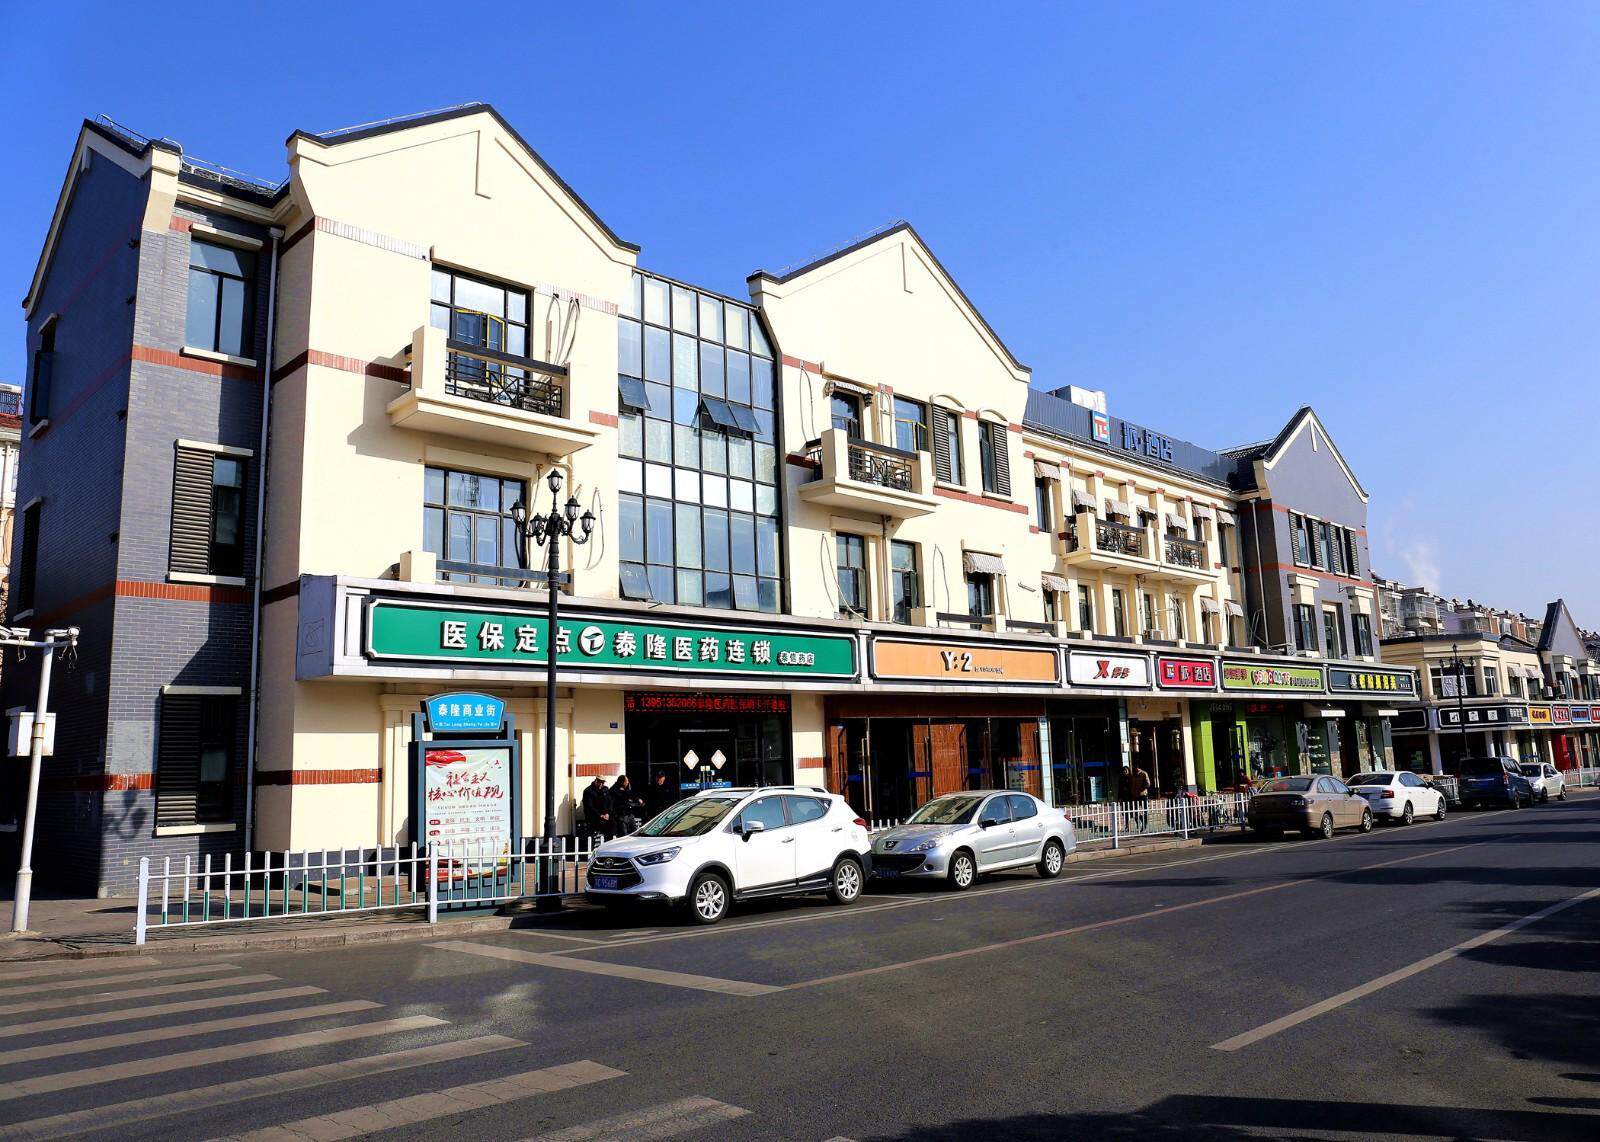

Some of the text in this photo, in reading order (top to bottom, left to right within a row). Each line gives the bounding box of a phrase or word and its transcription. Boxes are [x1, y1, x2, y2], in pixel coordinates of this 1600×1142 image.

[442, 620, 572, 654] 医保定点
[613, 630, 771, 663] 泰隆医药连锁
[438, 703, 496, 717] 泰隆商业街
[428, 785, 504, 801] 核心价值观
